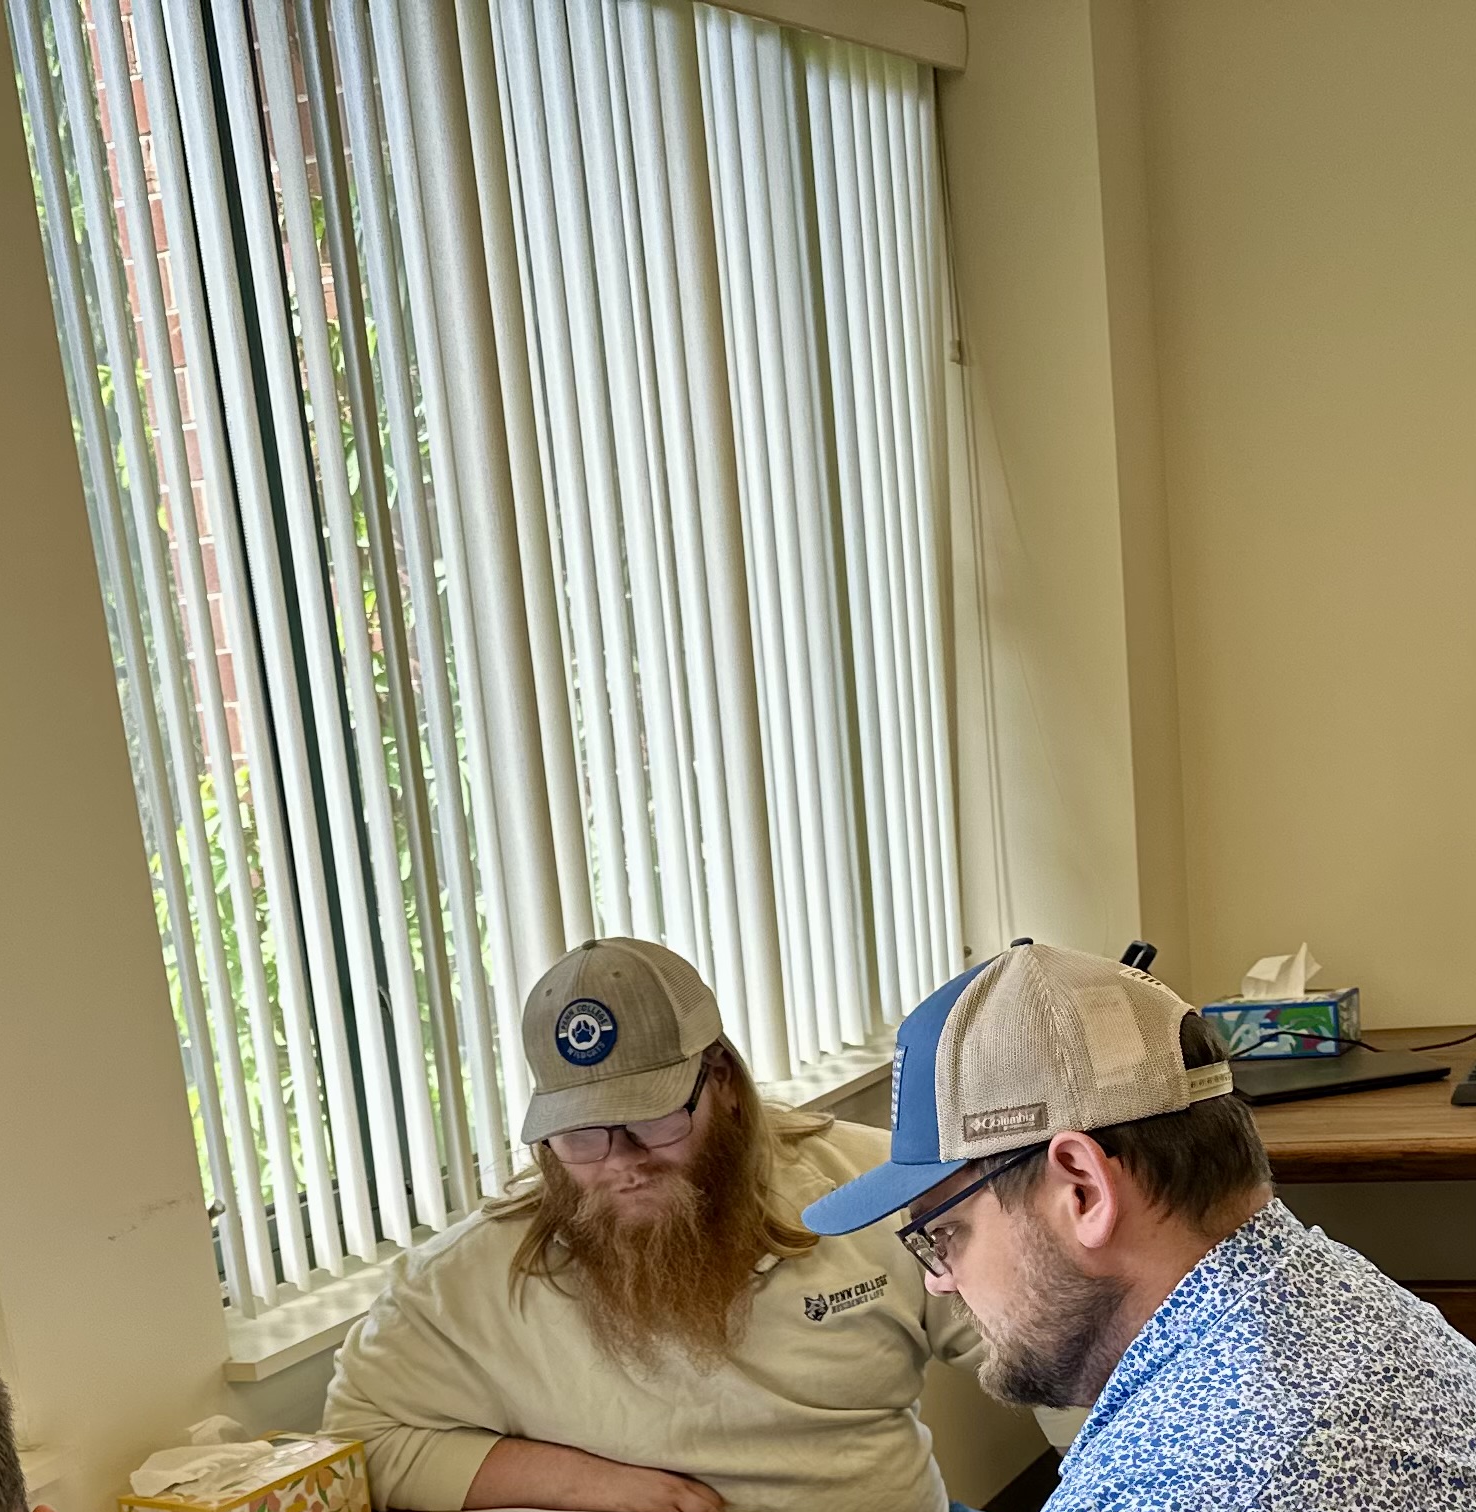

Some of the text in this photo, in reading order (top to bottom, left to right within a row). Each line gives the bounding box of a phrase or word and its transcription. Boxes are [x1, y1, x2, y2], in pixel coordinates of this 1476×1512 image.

[576, 1004, 609, 1025] COLLEGE
[982, 1111, 1035, 1129] Columbia
[828, 1274, 888, 1306] PENN COLLEGE
